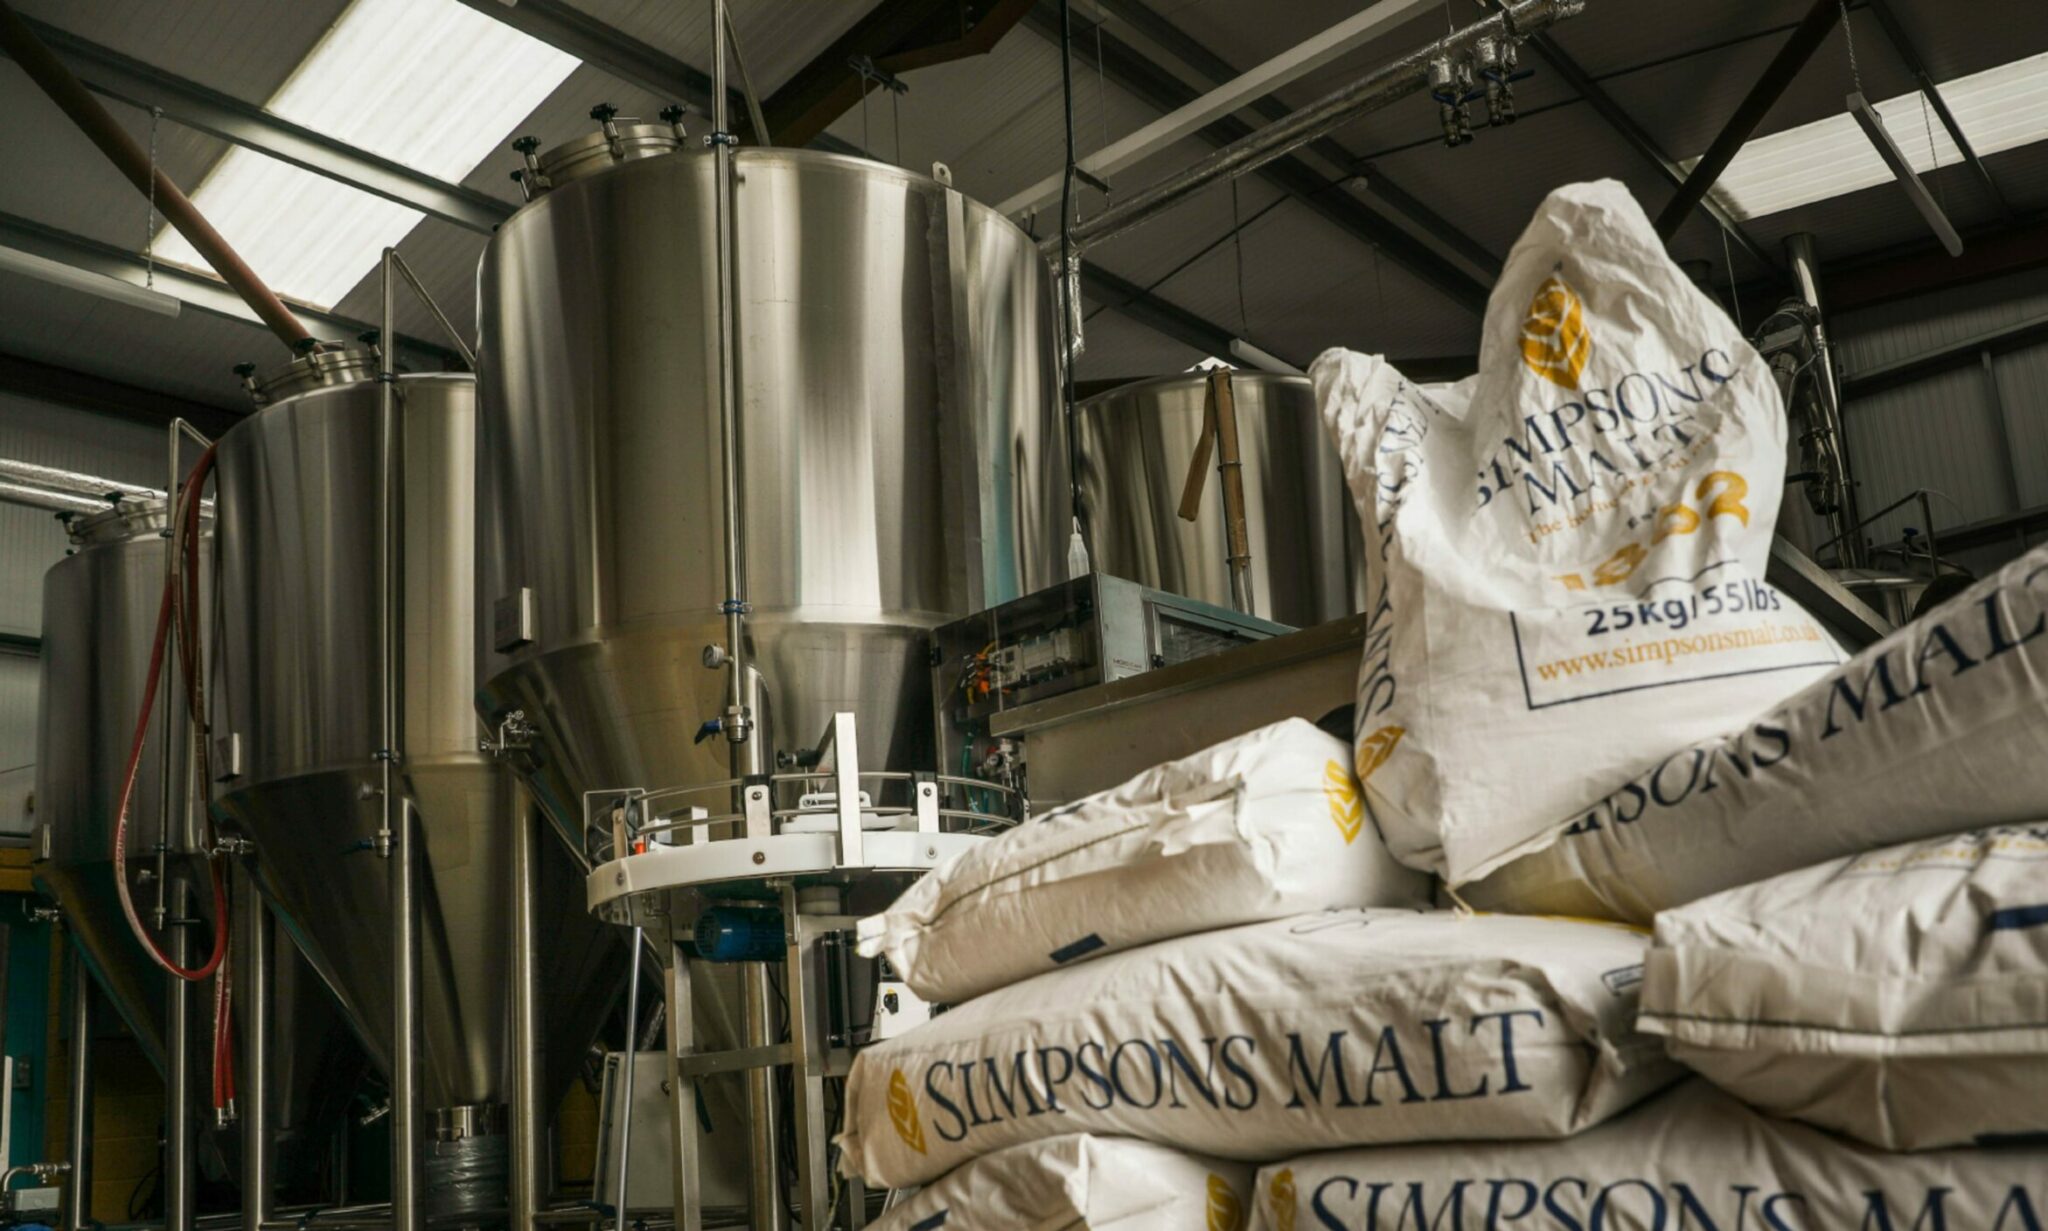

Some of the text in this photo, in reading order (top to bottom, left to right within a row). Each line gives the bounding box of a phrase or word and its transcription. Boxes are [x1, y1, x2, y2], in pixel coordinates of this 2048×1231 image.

[1819, 565, 2048, 740] MAL
[925, 1009, 1545, 1143] SIMPSONS MALT
[1311, 1177, 1806, 1231] SIMPSONS
